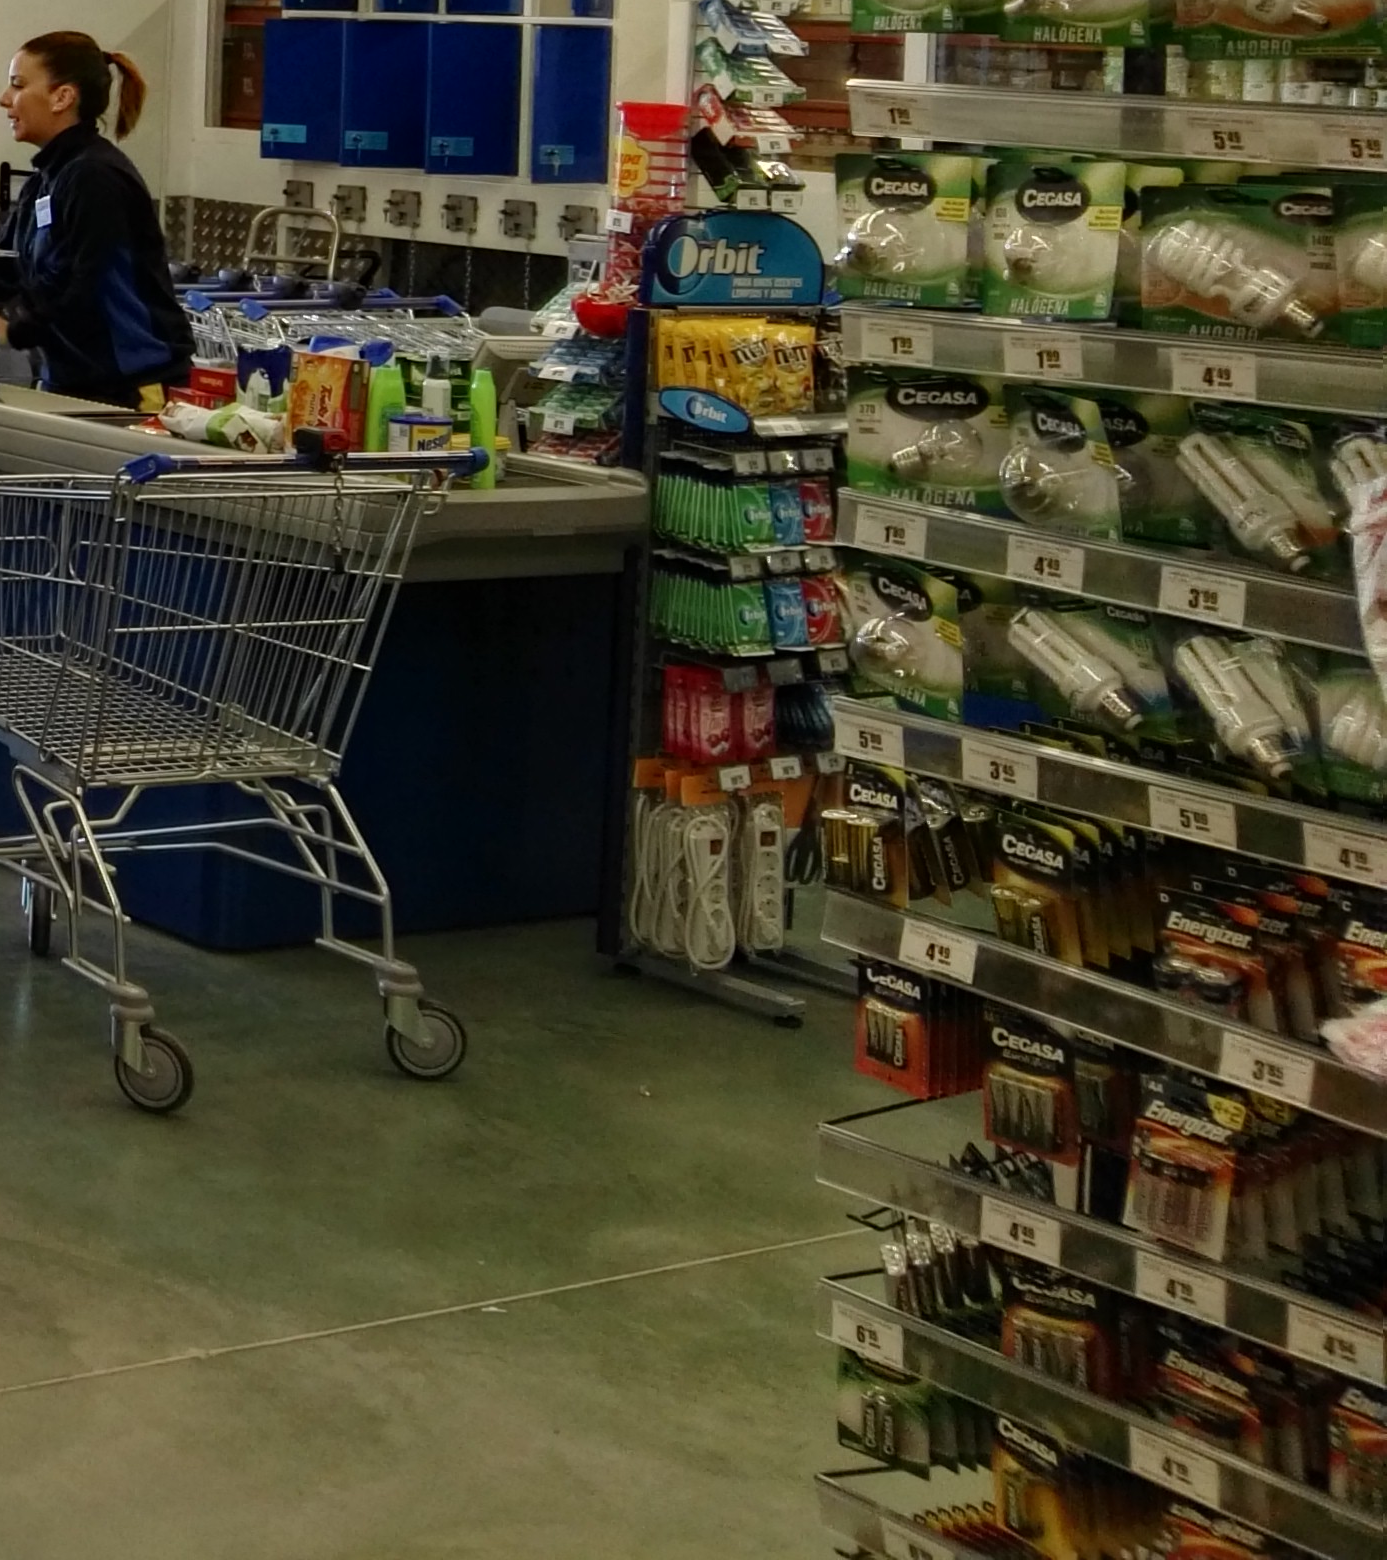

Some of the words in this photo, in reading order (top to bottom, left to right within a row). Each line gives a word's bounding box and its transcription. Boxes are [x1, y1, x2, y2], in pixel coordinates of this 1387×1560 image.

[870, 177, 929, 197] CEGASA
[1022, 189, 1082, 208] CEGASA
[1280, 201, 1333, 217] CEGAS
[667, 236, 767, 278] Orbit
[896, 388, 978, 406] CEGASA
[877, 575, 927, 612] CEGASA
[849, 783, 898, 810] CEGASA
[872, 836, 885, 891] CEGASA
[1001, 833, 1065, 871] CEGASA
[1166, 910, 1253, 950] Energizer
[991, 1026, 1065, 1065] CEGASA
[1144, 1099, 1233, 1144] Energizer
